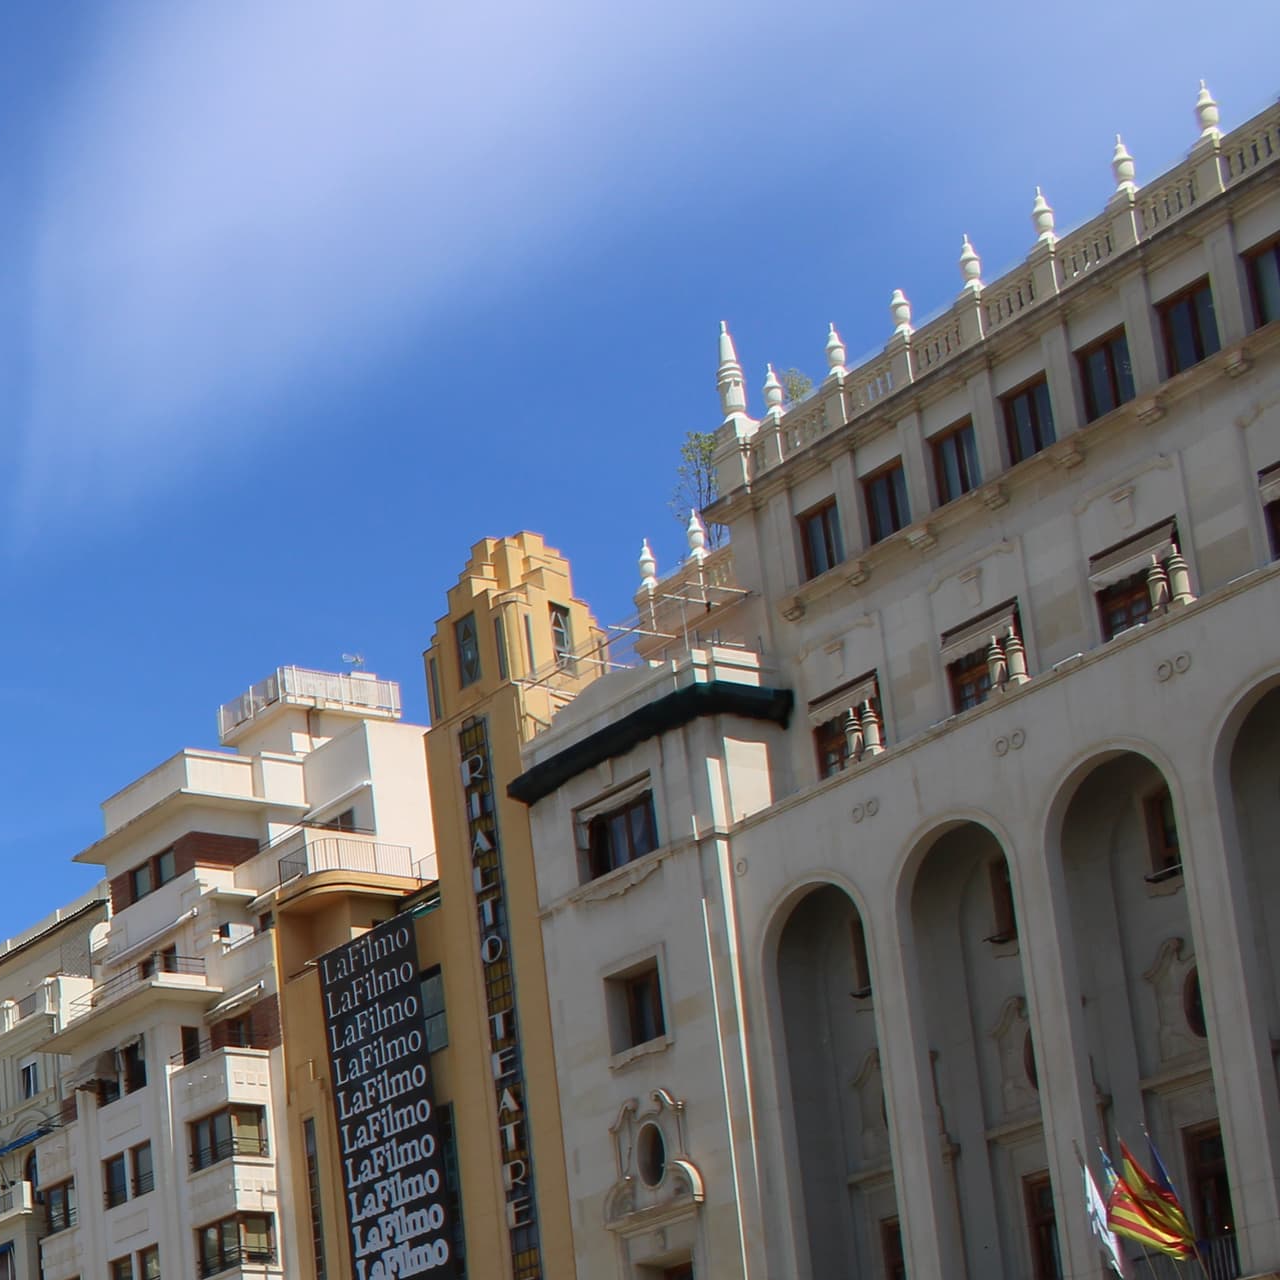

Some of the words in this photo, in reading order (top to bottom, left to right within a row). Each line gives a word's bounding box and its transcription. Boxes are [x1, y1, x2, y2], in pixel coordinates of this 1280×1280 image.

[461, 754, 503, 964] RIALTO
[324, 927, 409, 985] LaFilmo
[326, 961, 413, 1019] LaFilmo
[330, 996, 418, 1053] LaFilmo
[334, 1030, 422, 1086] LaFilmo
[337, 1064, 426, 1120] LaFilmo
[488, 1007, 532, 1230] TEATRE
[341, 1099, 431, 1154] LaFilmo
[345, 1134, 435, 1188] LaFilmo
[349, 1169, 439, 1223] LaFilmo
[352, 1203, 444, 1258] LaFilmo
